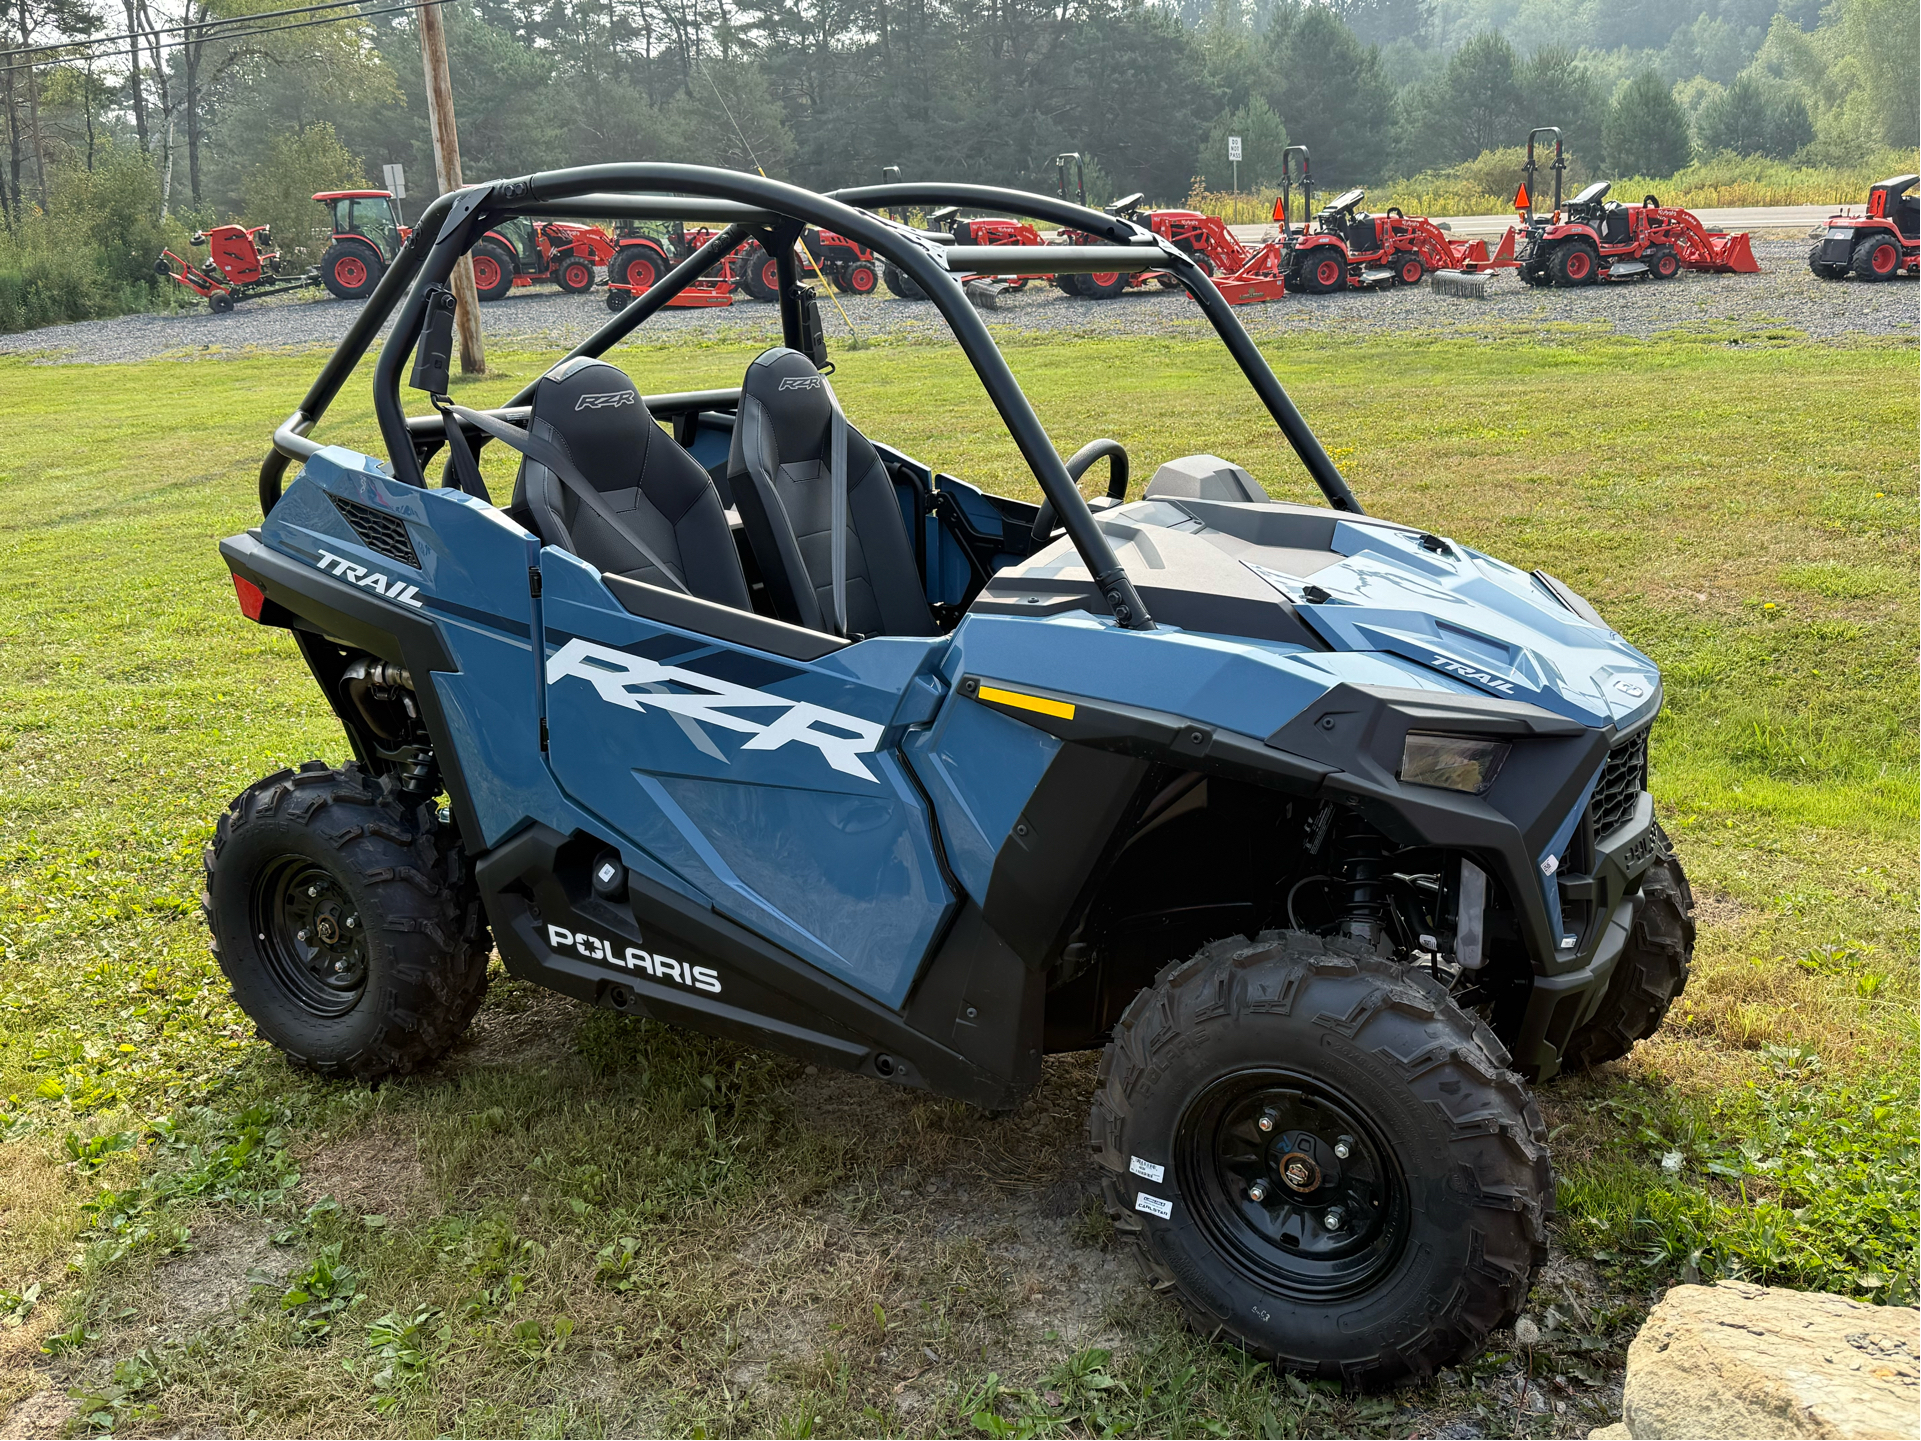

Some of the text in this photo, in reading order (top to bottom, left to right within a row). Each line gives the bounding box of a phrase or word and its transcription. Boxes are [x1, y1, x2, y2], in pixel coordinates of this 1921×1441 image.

[574, 390, 635, 412] RZR
[777, 376, 821, 391] RZR
[317, 549, 424, 608] TRAIL
[1431, 655, 1515, 695] TRAIL
[545, 638, 885, 784] RZR
[547, 924, 722, 993] POLARIS
